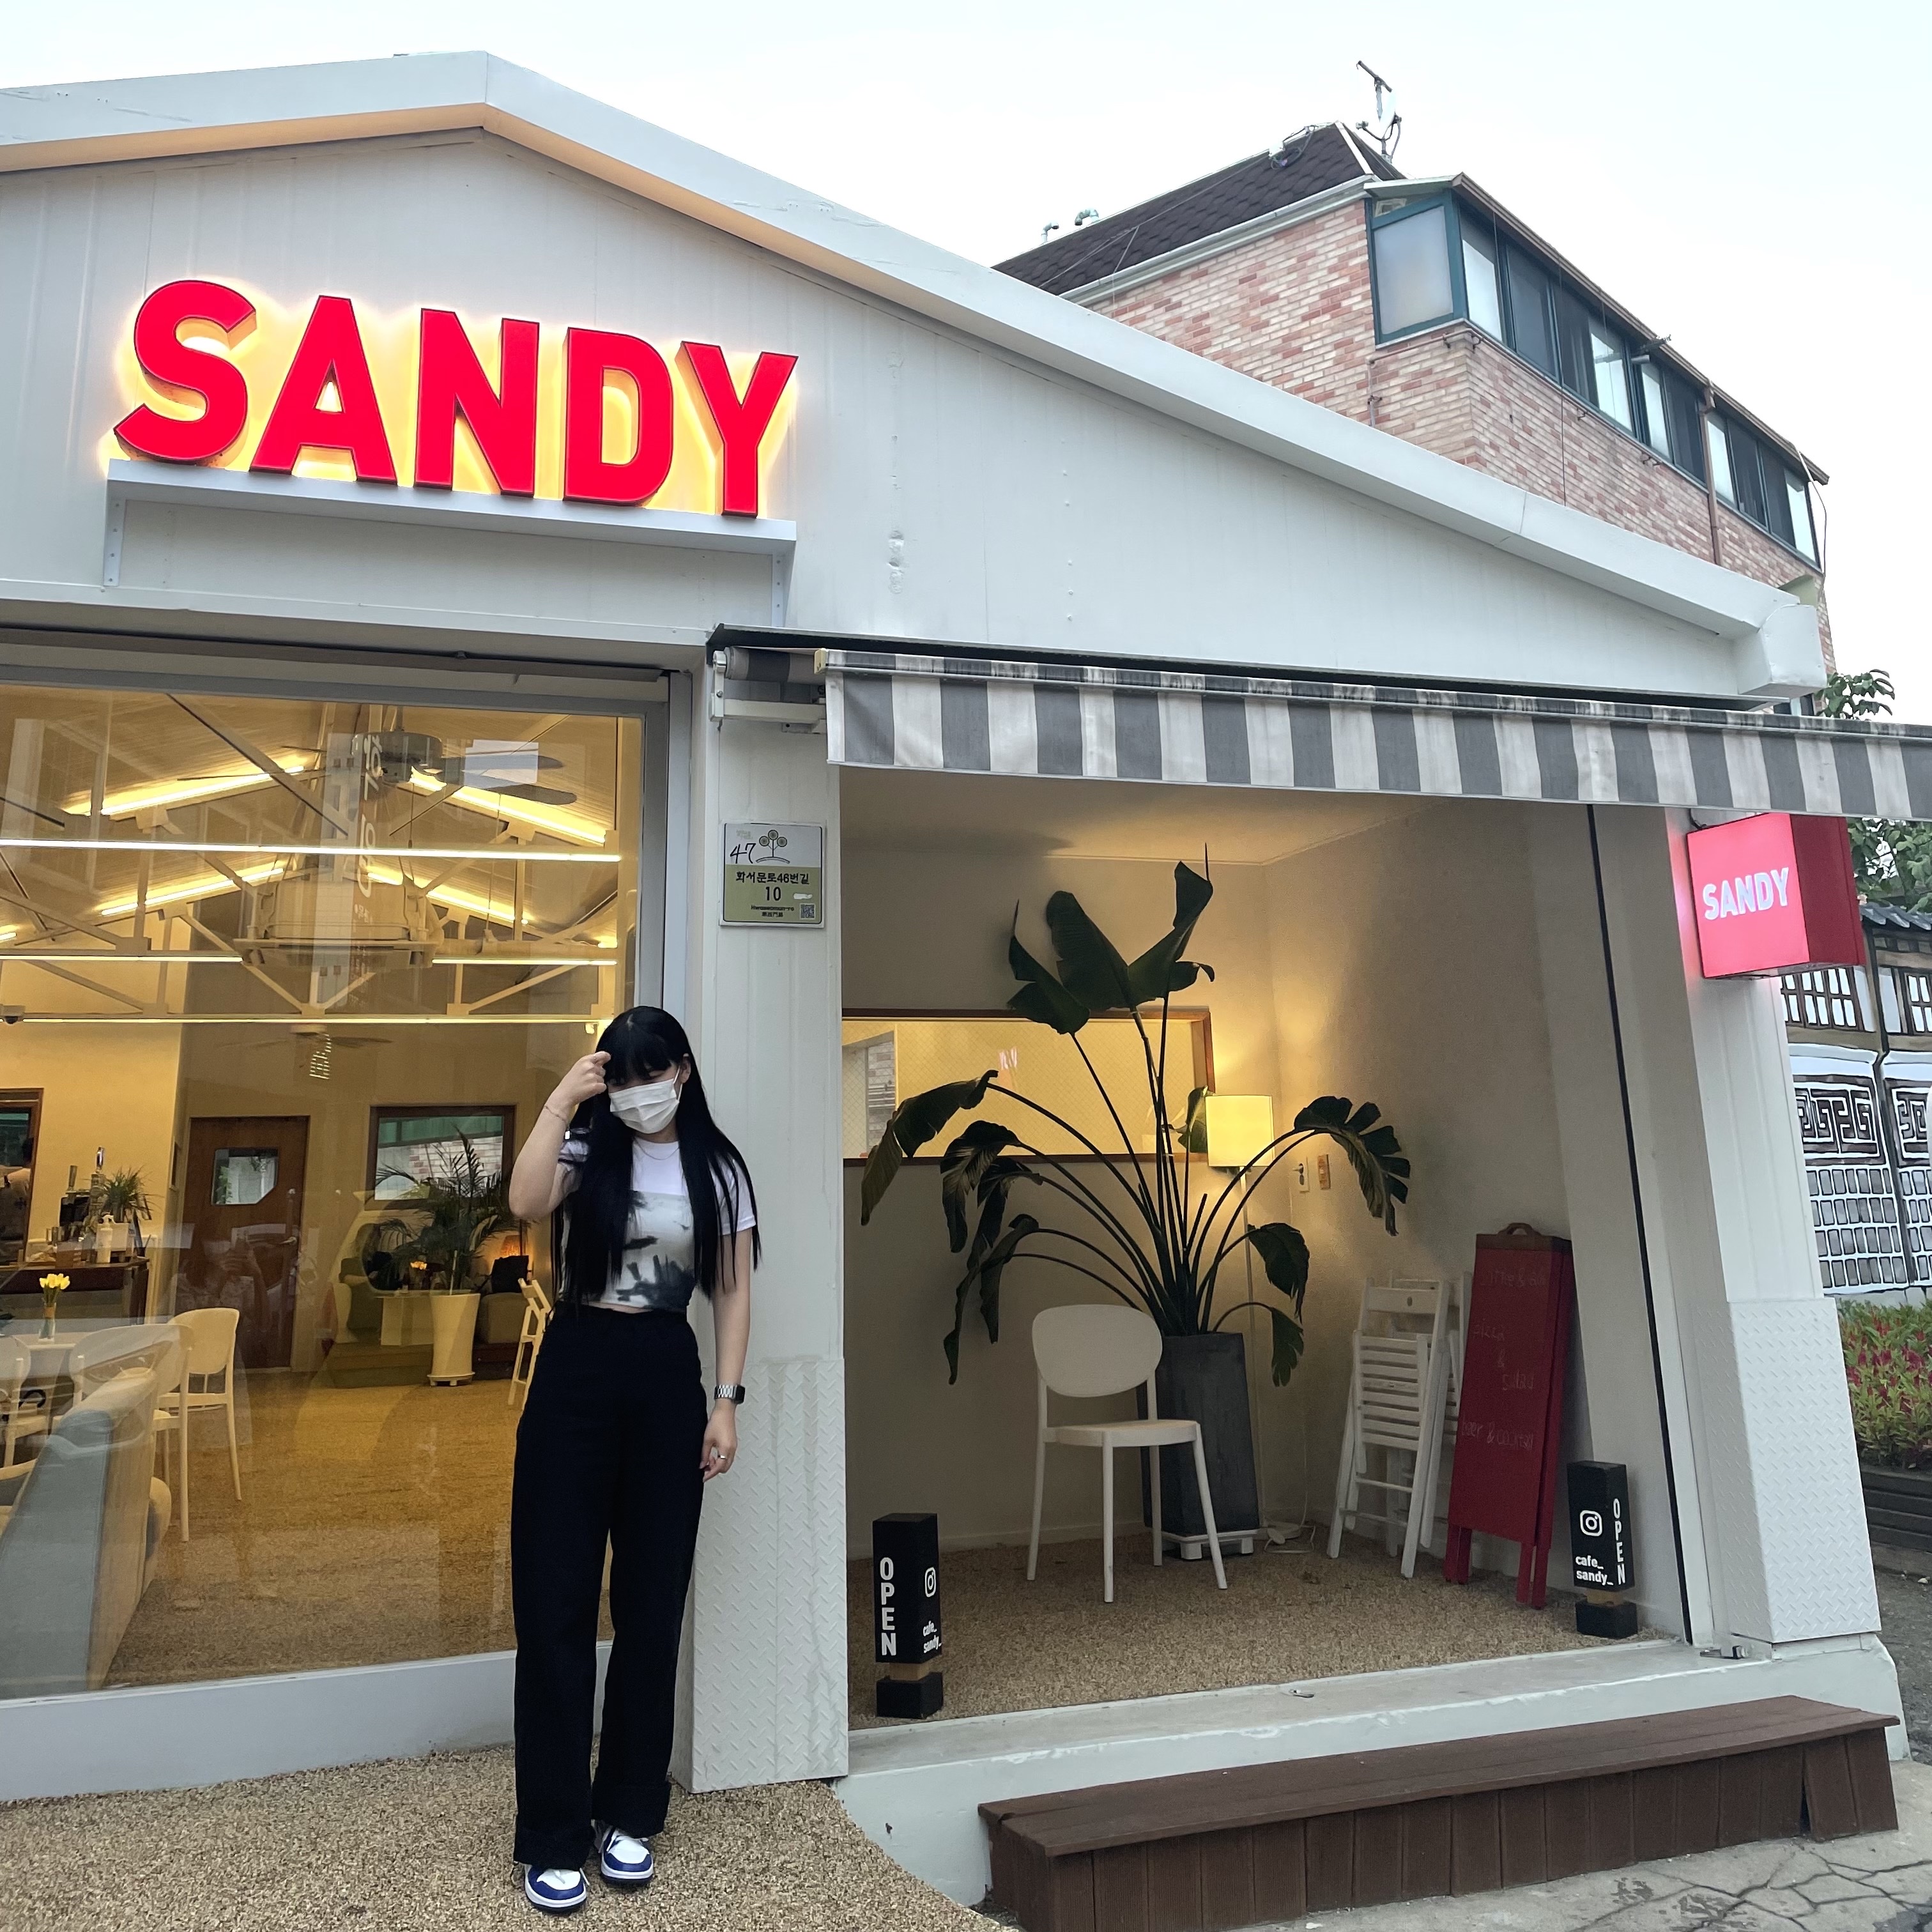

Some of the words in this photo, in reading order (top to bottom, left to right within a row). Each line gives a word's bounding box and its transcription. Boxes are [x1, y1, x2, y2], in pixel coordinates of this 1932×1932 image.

[113, 279, 799, 518] SANDY
[730, 843, 756, 864] 47
[735, 871, 810, 885] 화서문로46번길
[765, 886, 781, 901] 10
[1702, 866, 1790, 921] SANDY
[1612, 1498, 1626, 1585] OPEN
[1576, 1570, 1614, 1586] sandy_
[879, 1556, 897, 1657] OPEN
